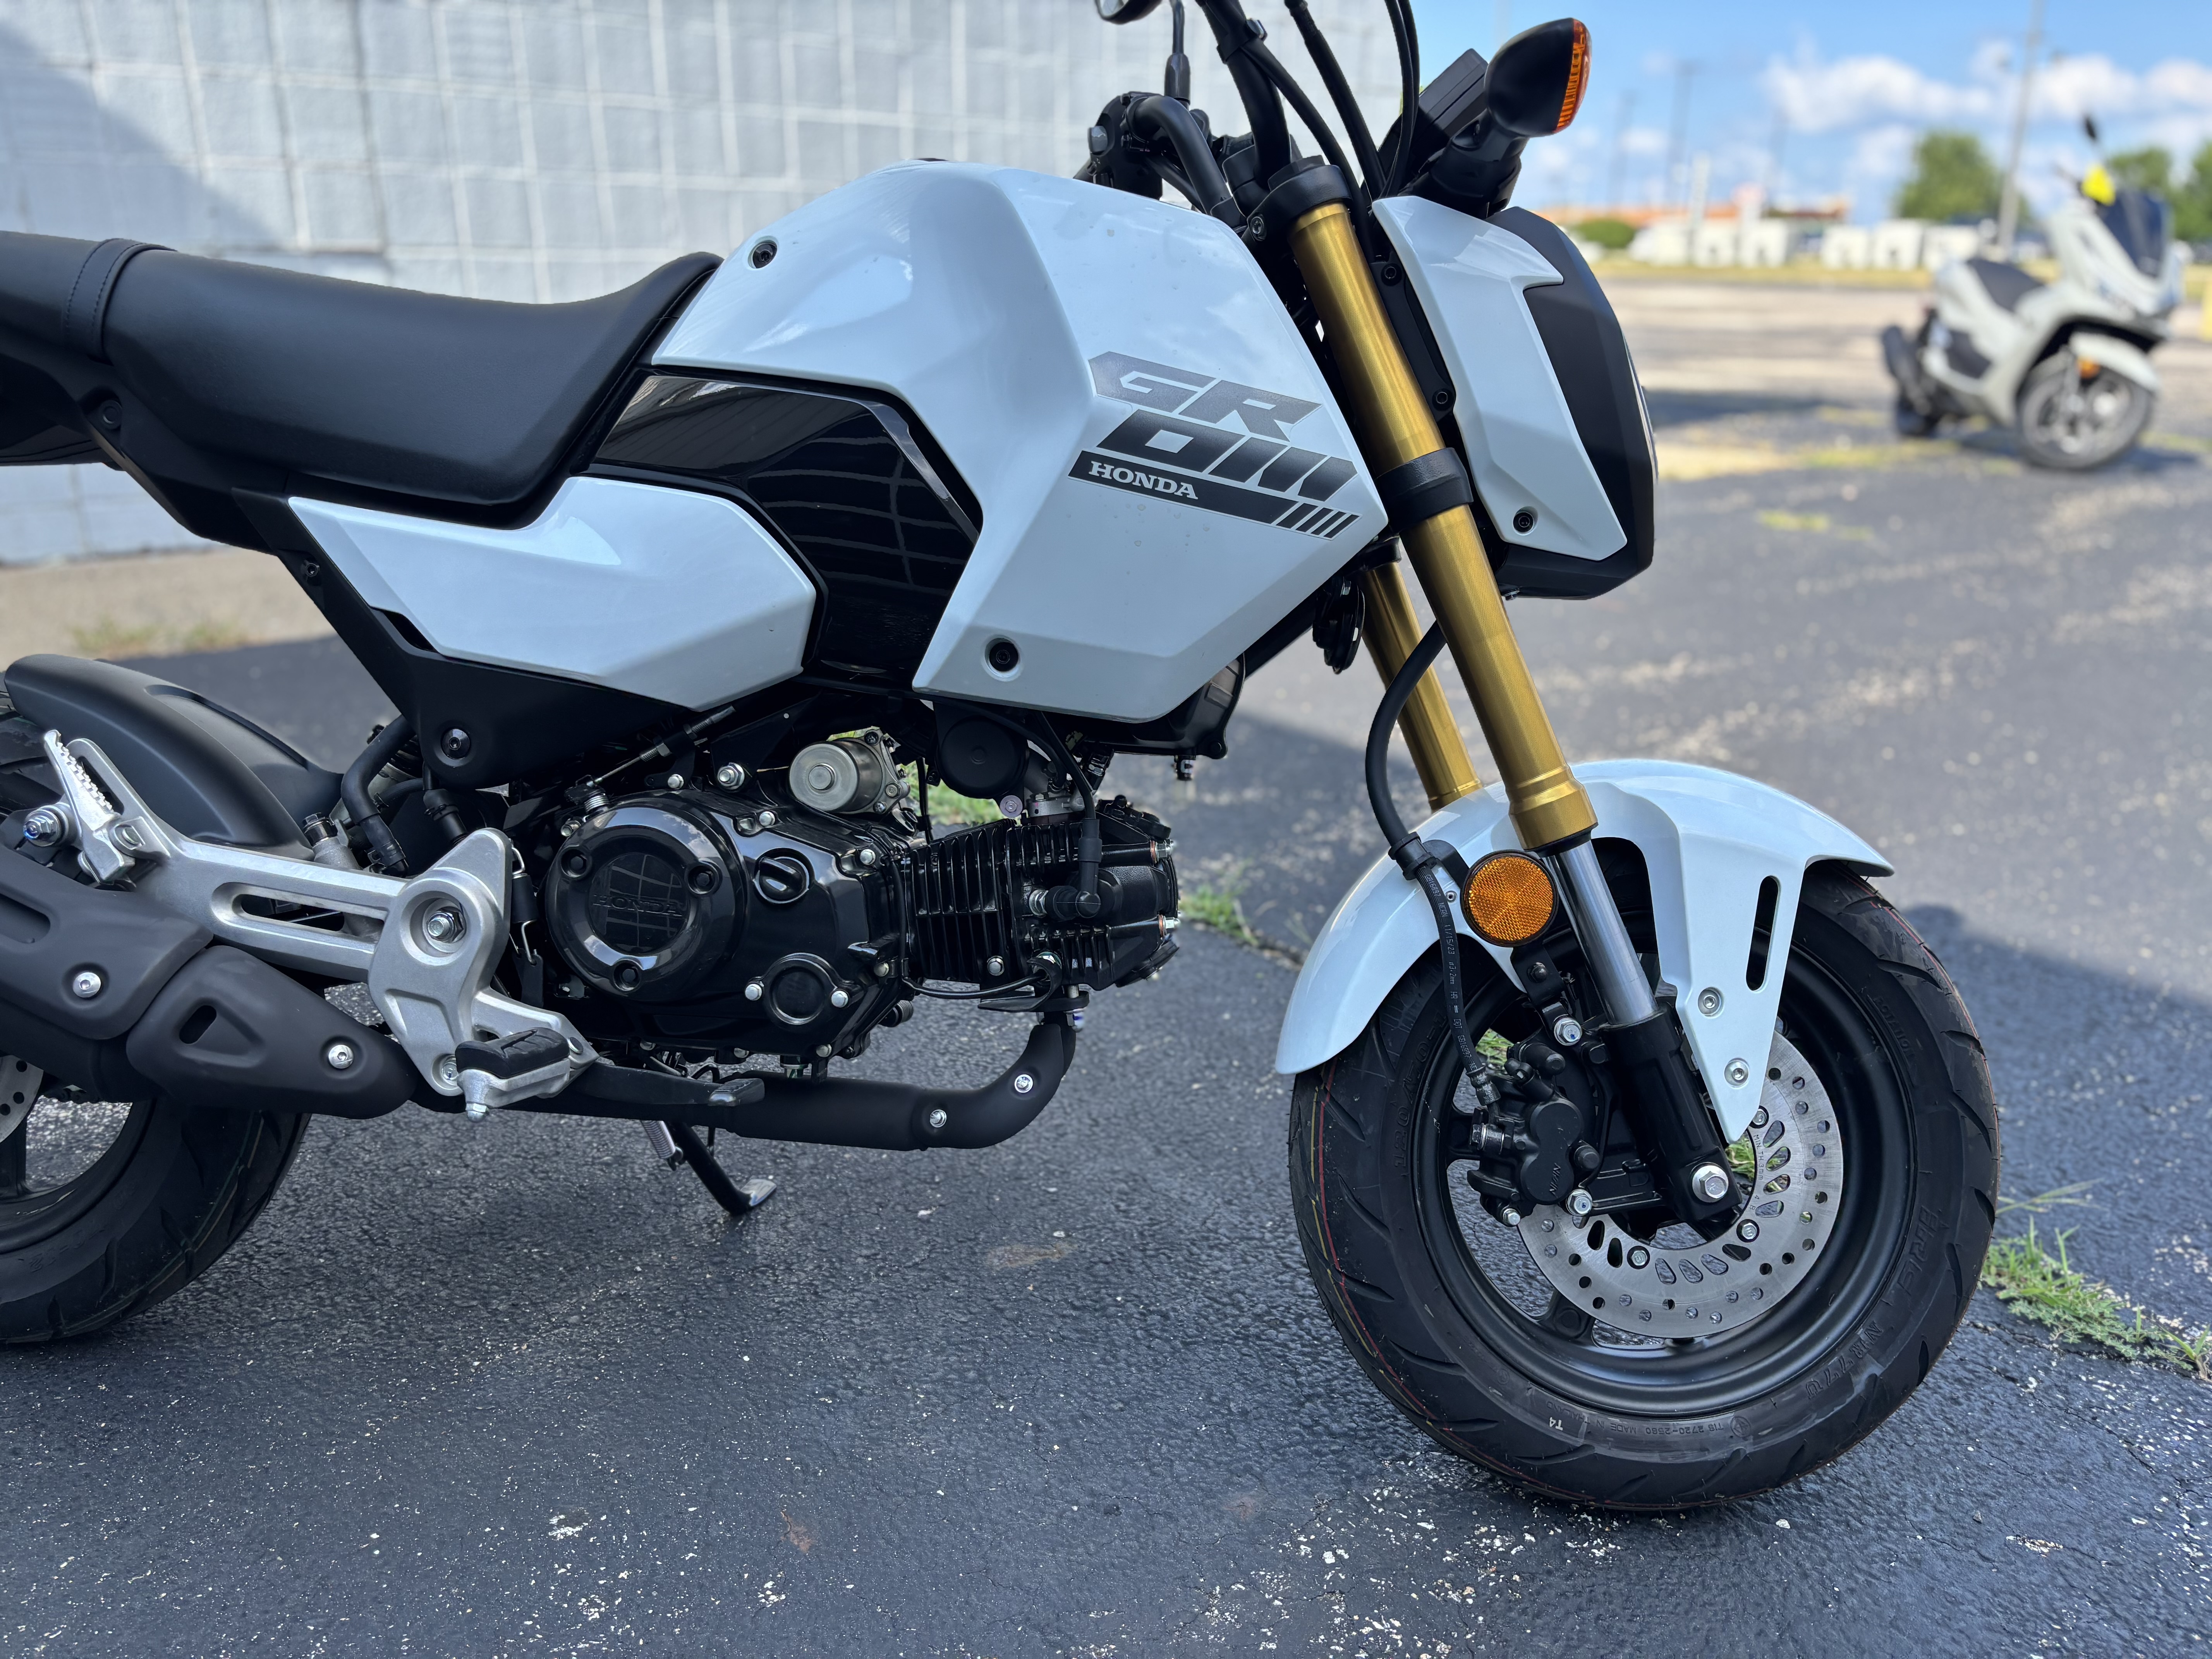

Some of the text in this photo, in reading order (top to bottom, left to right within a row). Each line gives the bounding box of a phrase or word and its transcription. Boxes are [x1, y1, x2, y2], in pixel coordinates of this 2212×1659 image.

[1088, 460, 1199, 500] HONDA
[592, 893, 684, 917] HONDA
[1444, 925, 1455, 955] 11/15/23
[1395, 1014, 1447, 1168] 120/70-1
[1546, 1400, 1637, 1434] MADE IN THAILAND
[1549, 1417, 1563, 1431] T4
